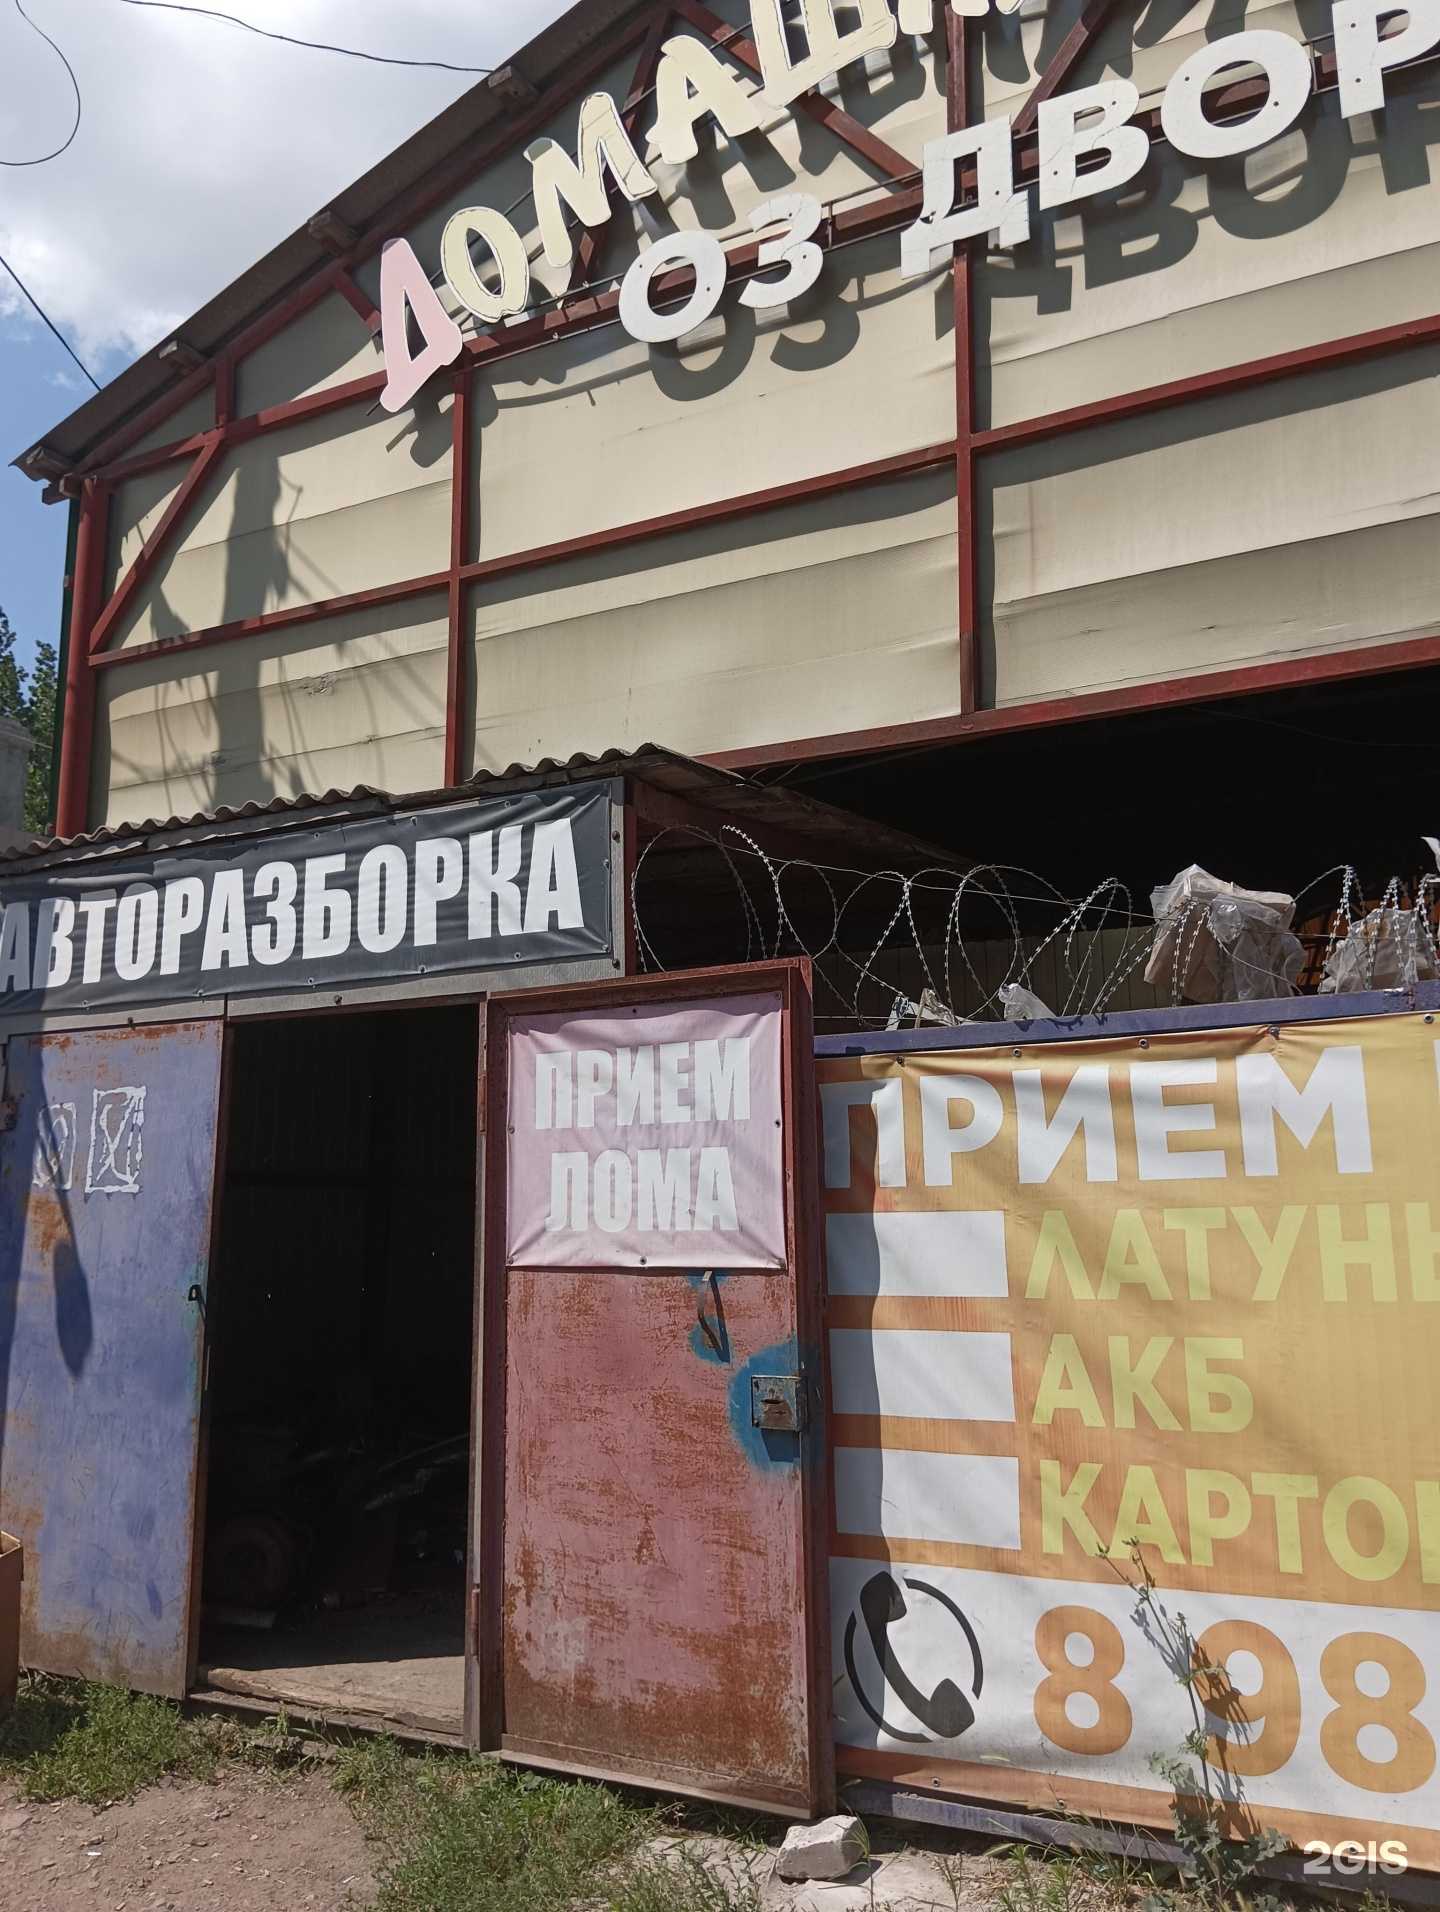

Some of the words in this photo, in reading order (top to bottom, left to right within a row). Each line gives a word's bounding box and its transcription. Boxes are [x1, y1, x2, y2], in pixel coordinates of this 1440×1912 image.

[900, 0, 1440, 280] ДВОР
[0, 817, 584, 992] АВТОРАЗБОРКА
[535, 1036, 751, 1130] ПРИЕМ
[819, 1045, 1373, 1189] ПРИЕМ
[544, 1146, 739, 1233] ЛОМА
[1032, 1333, 1254, 1453] АКБ
[1033, 1605, 1133, 1756] 8
